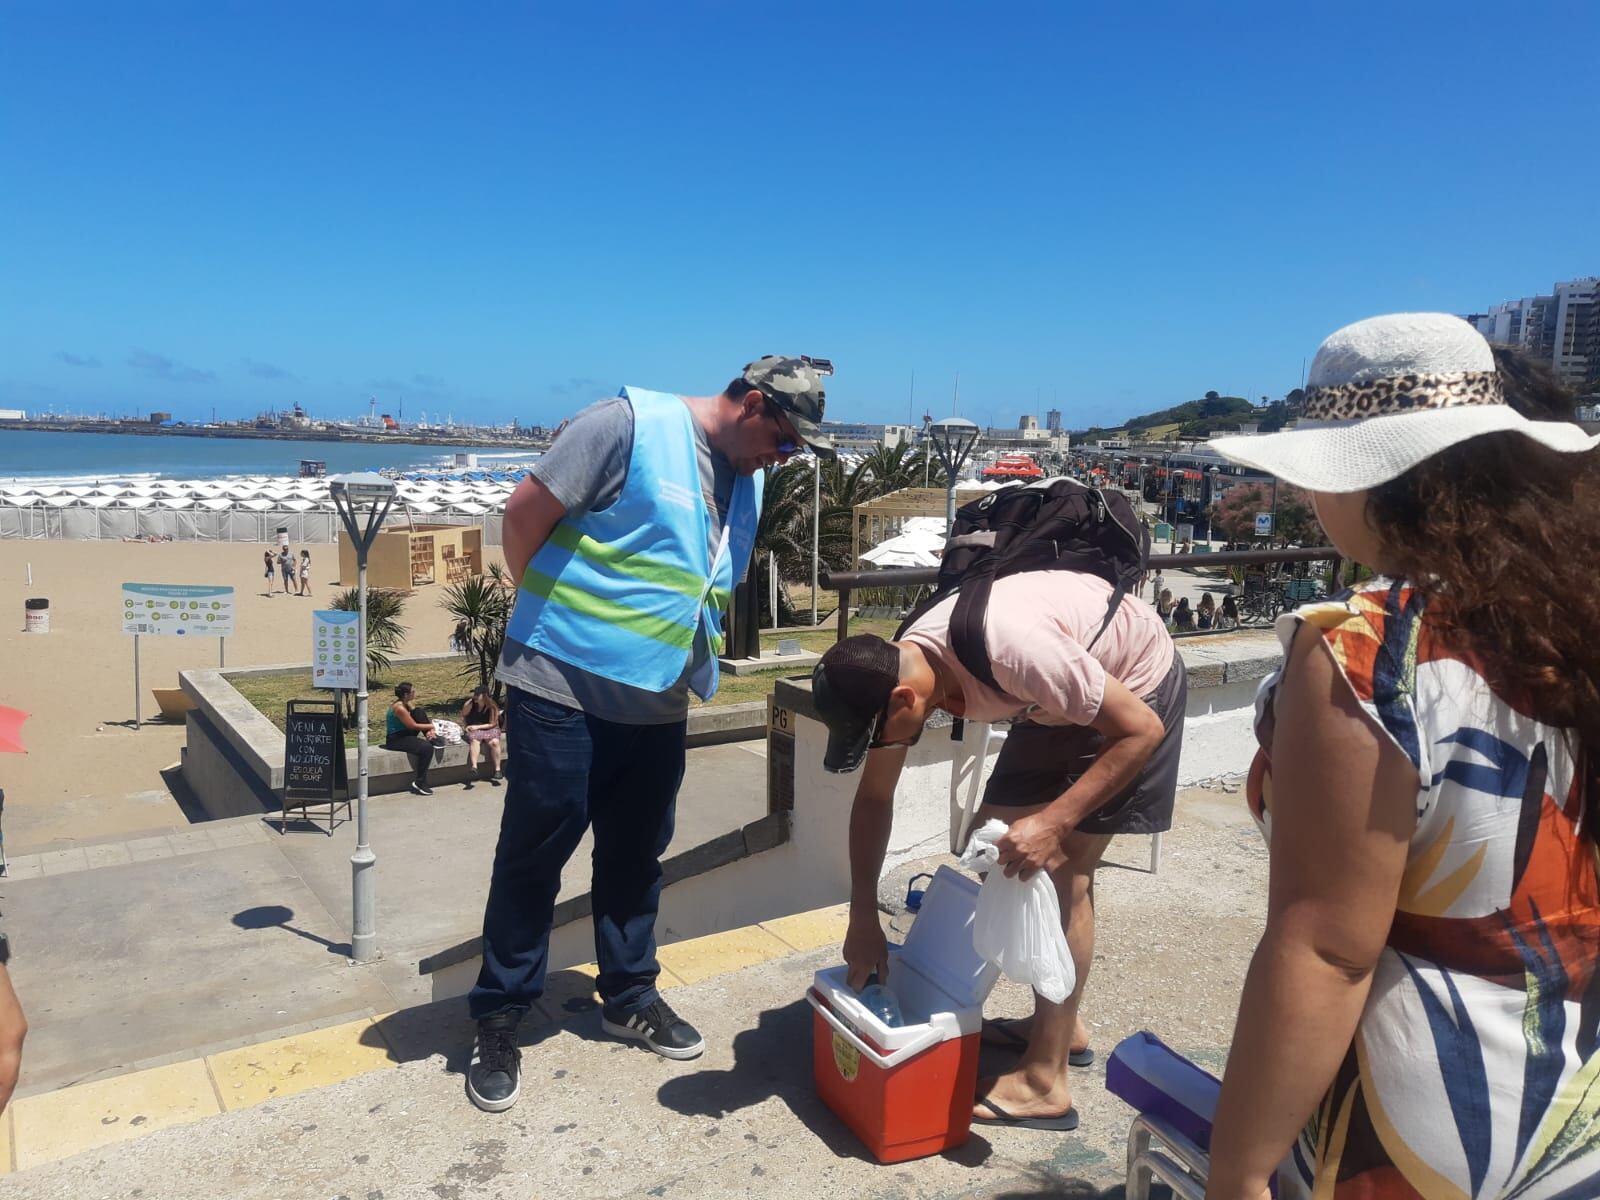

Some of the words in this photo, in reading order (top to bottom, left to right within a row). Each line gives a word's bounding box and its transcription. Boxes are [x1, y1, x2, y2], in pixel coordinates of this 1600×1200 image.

[772, 705, 788, 729] PG
[319, 722, 327, 733] A
[298, 745, 315, 754] CON
[289, 754, 330, 765] NOSOTROS
[293, 765, 323, 774] ESCUELA
[303, 774, 322, 782] SURF
